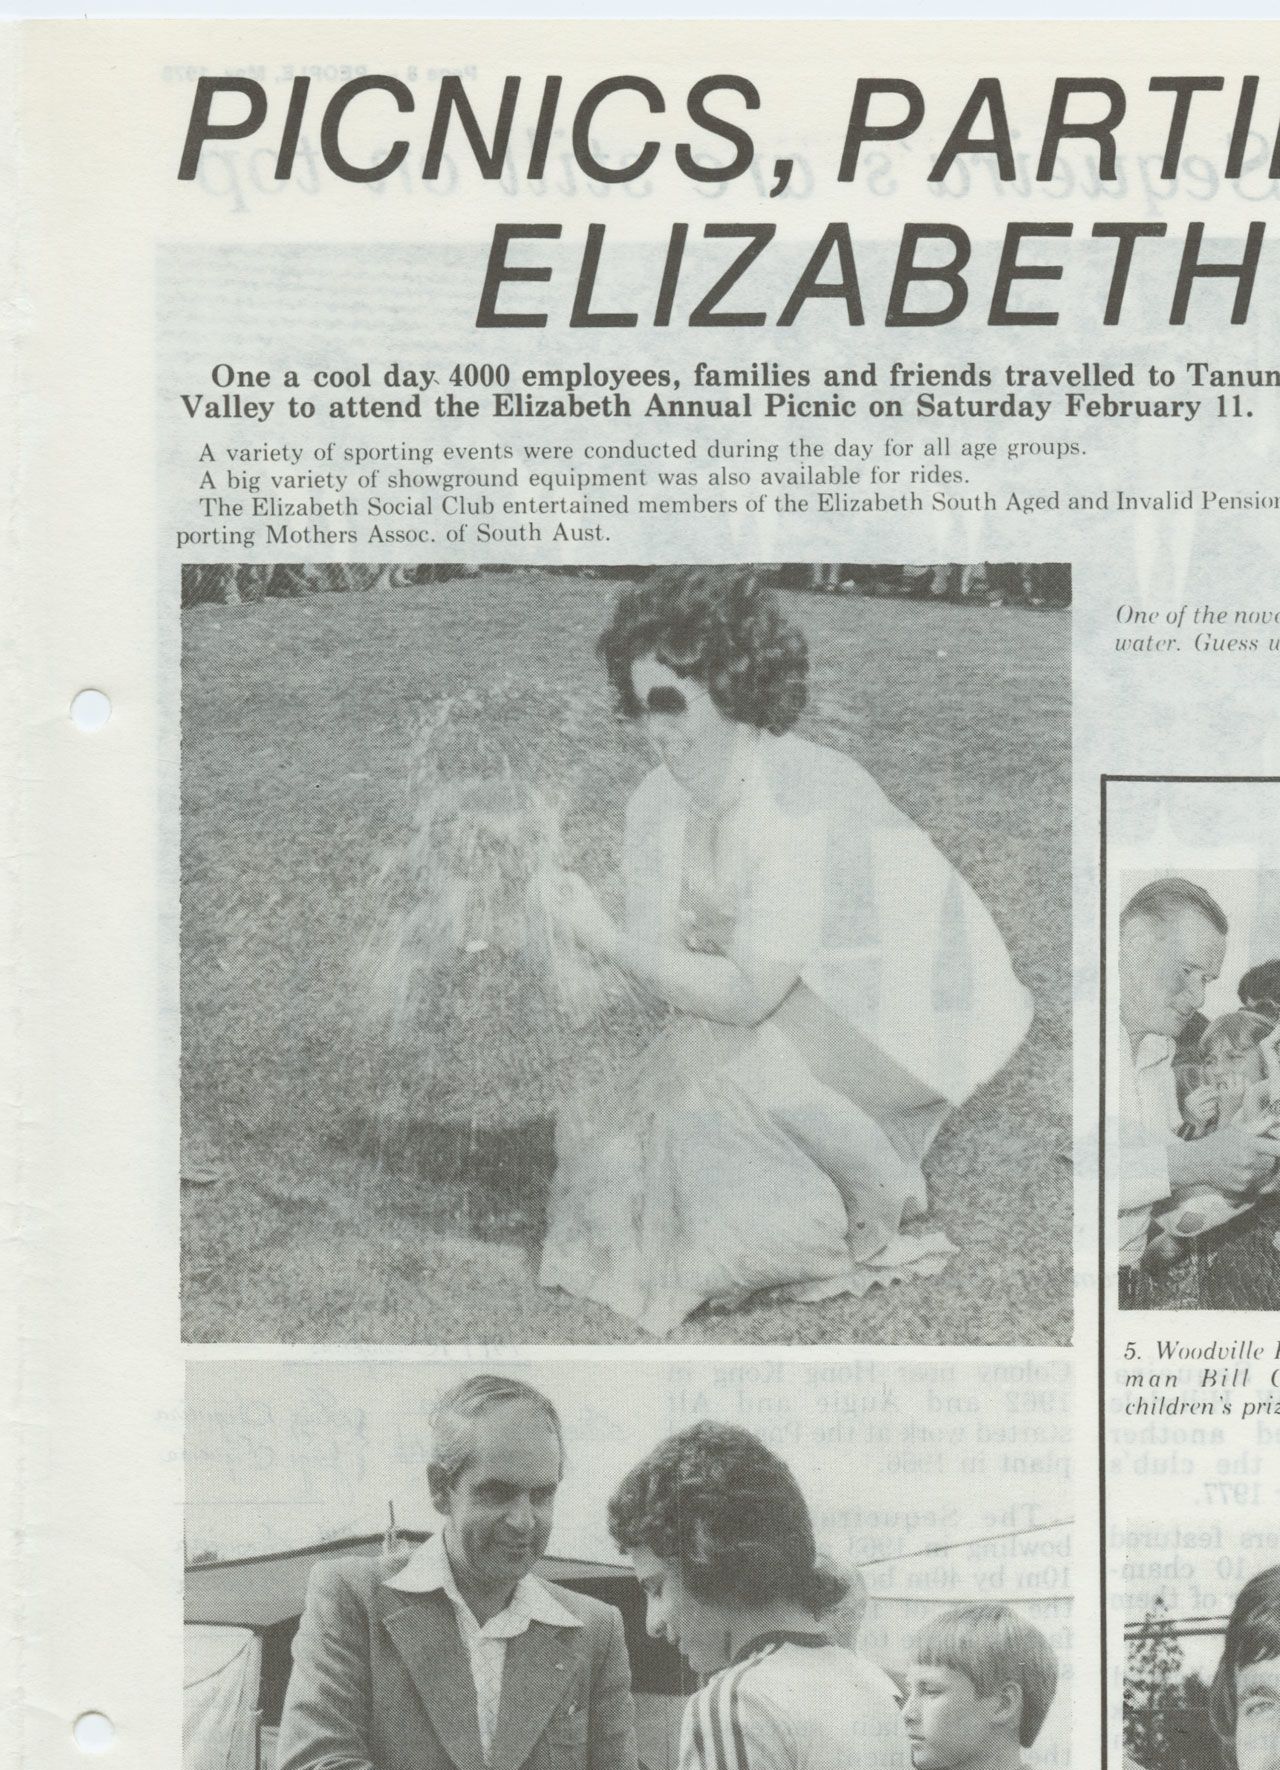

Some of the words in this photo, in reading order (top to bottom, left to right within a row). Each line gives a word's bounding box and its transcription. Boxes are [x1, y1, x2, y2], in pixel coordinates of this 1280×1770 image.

[178, 75, 793, 198] PICNICS,
[476, 221, 1266, 328] ELIZABETH
[211, 363, 271, 388] One
[283, 370, 301, 388] a
[313, 362, 372, 388] cool
[448, 363, 511, 388] 4000
[521, 362, 681, 392] employees,
[693, 361, 811, 387] families
[823, 362, 878, 387] and
[889, 362, 992, 387] friends
[1005, 362, 1135, 387] travelled
[1148, 364, 1176, 388] to
[179, 393, 275, 423] Valley
[287, 396, 316, 419] to
[328, 393, 422, 419] attend
[434, 393, 480, 418] the
[492, 392, 632, 418] Elizabeth
[643, 392, 753, 418] Annual
[764, 392, 857, 418] Picnic
[868, 400, 904, 418] on
[916, 392, 1052, 422] Saturday
[1064, 392, 1202, 422] February
[1217, 394, 1253, 418] 11.
[1116, 605, 1161, 624] One
[1166, 604, 1188, 628] of
[1193, 604, 1228, 624] the
[1115, 635, 1181, 652] water.
[1194, 633, 1259, 652] Guess
[1123, 1341, 1141, 1360] 5.
[1157, 1340, 1264, 1360] Woodville
